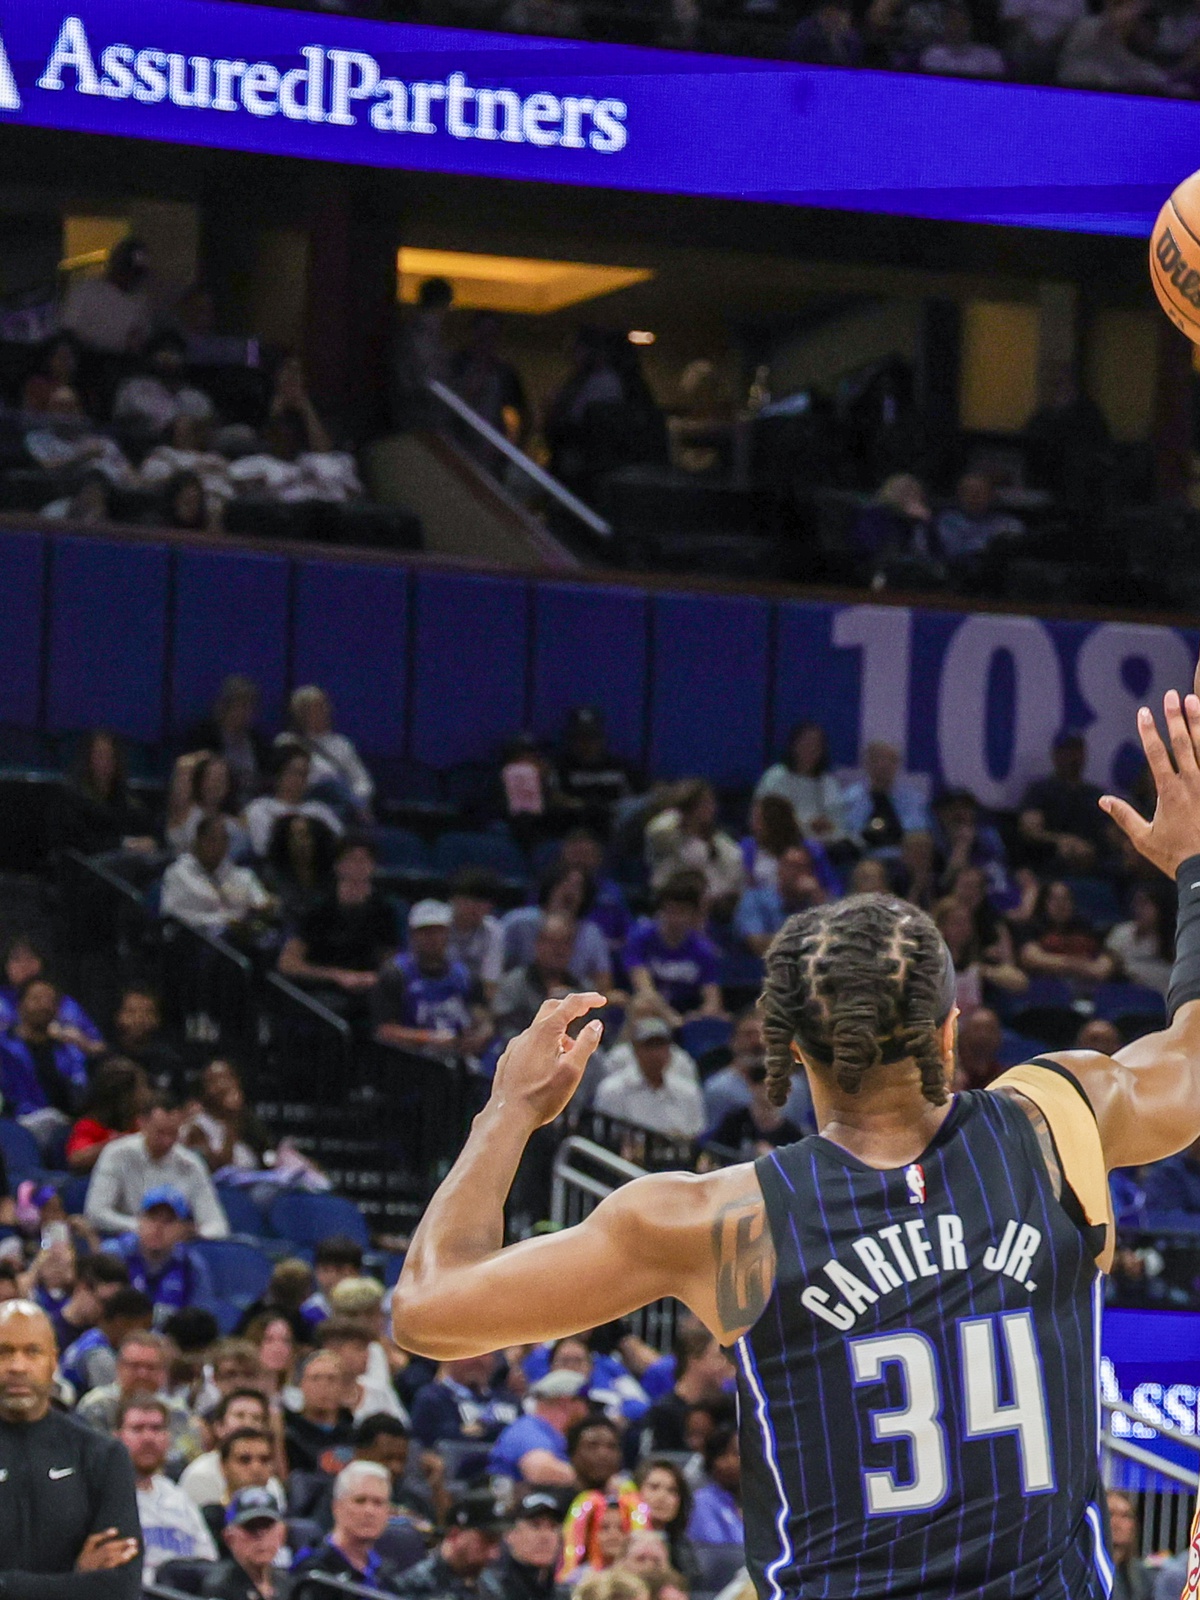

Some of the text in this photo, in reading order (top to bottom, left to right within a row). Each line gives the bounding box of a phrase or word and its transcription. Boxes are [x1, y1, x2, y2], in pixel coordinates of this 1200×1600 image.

[37, 15, 630, 153] AssuredPartners
[831, 606, 1197, 806] 108
[801, 1215, 1042, 1331] CARTER JR.
[845, 1308, 1058, 1517] 34
